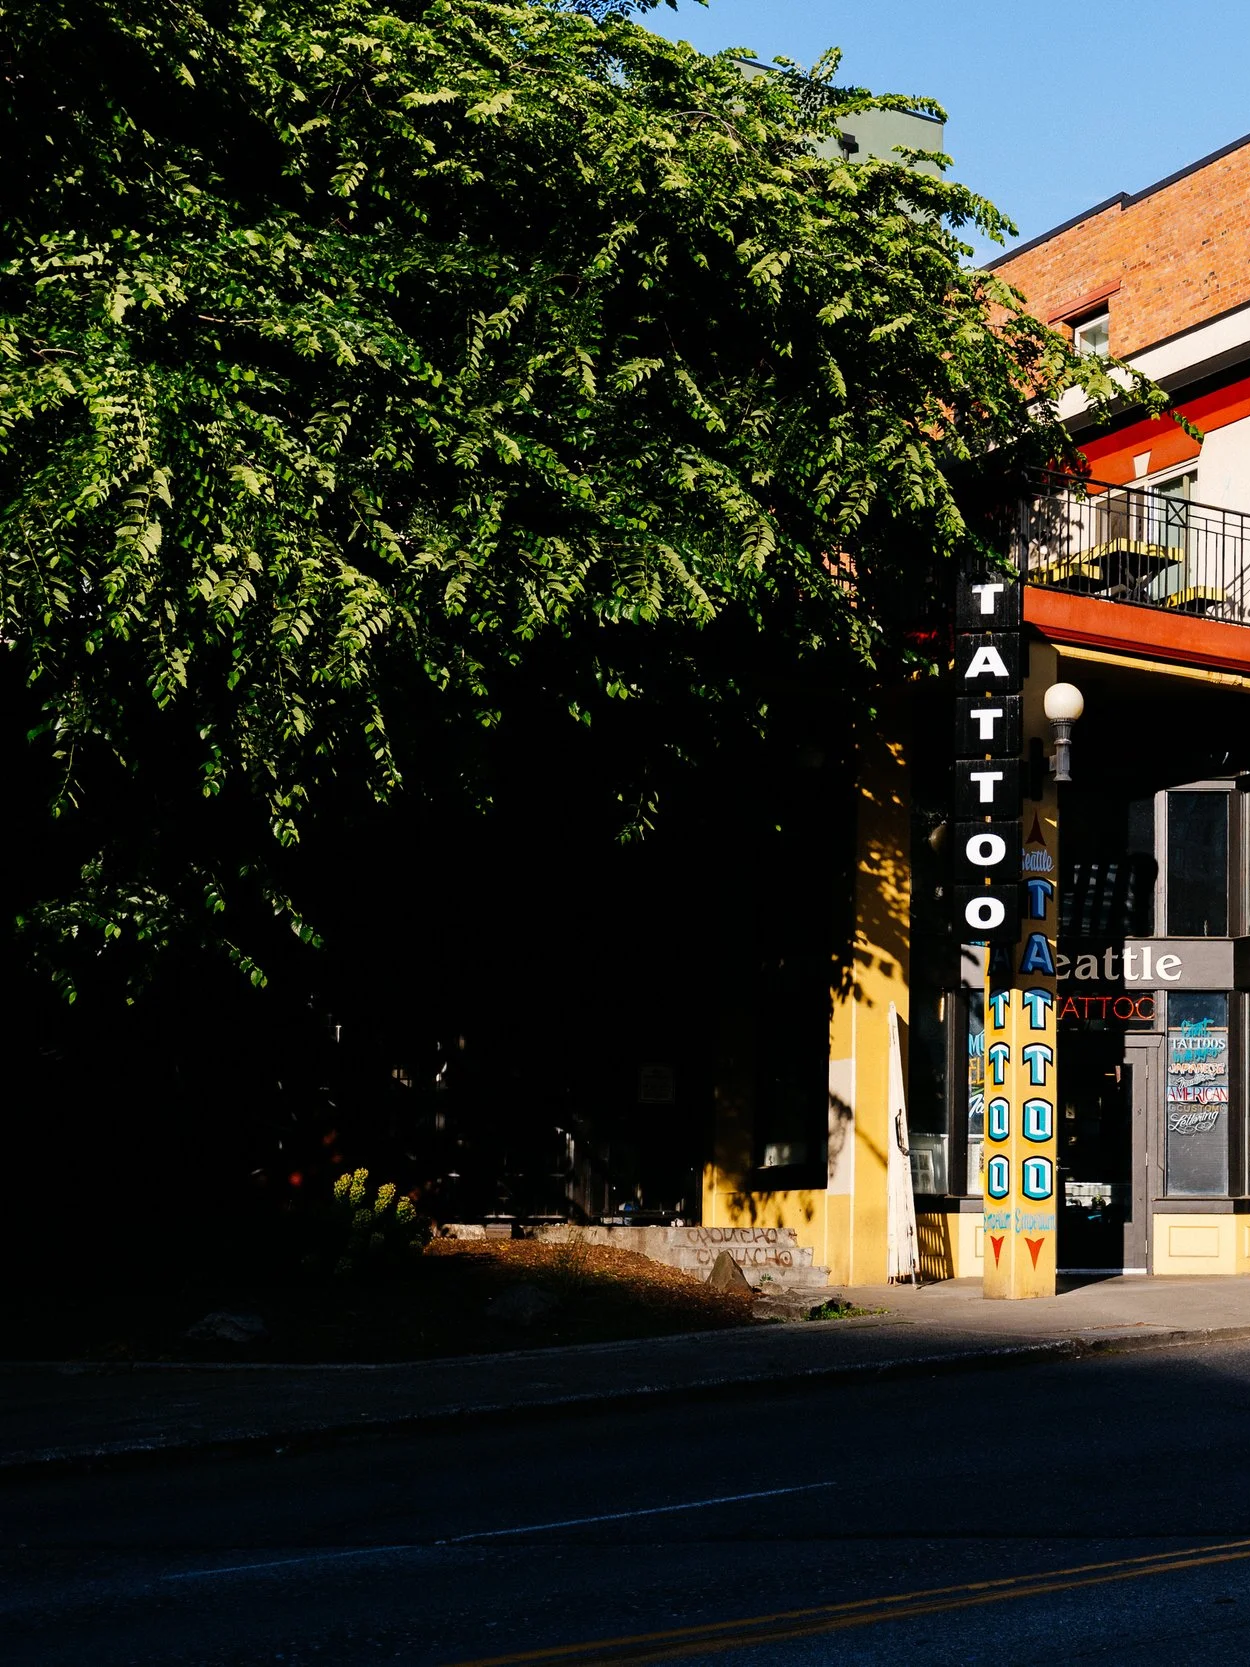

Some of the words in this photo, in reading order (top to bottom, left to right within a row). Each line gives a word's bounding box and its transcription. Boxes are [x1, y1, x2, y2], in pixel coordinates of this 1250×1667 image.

[964, 583, 1009, 930] TATTOO
[1021, 848, 1055, 872] eattle
[1056, 946, 1183, 981] eattle
[1020, 877, 1056, 1201] TATTOO
[1172, 1037, 1227, 1050] TATTOOS
[1167, 1086, 1229, 1104] AMERICAN
